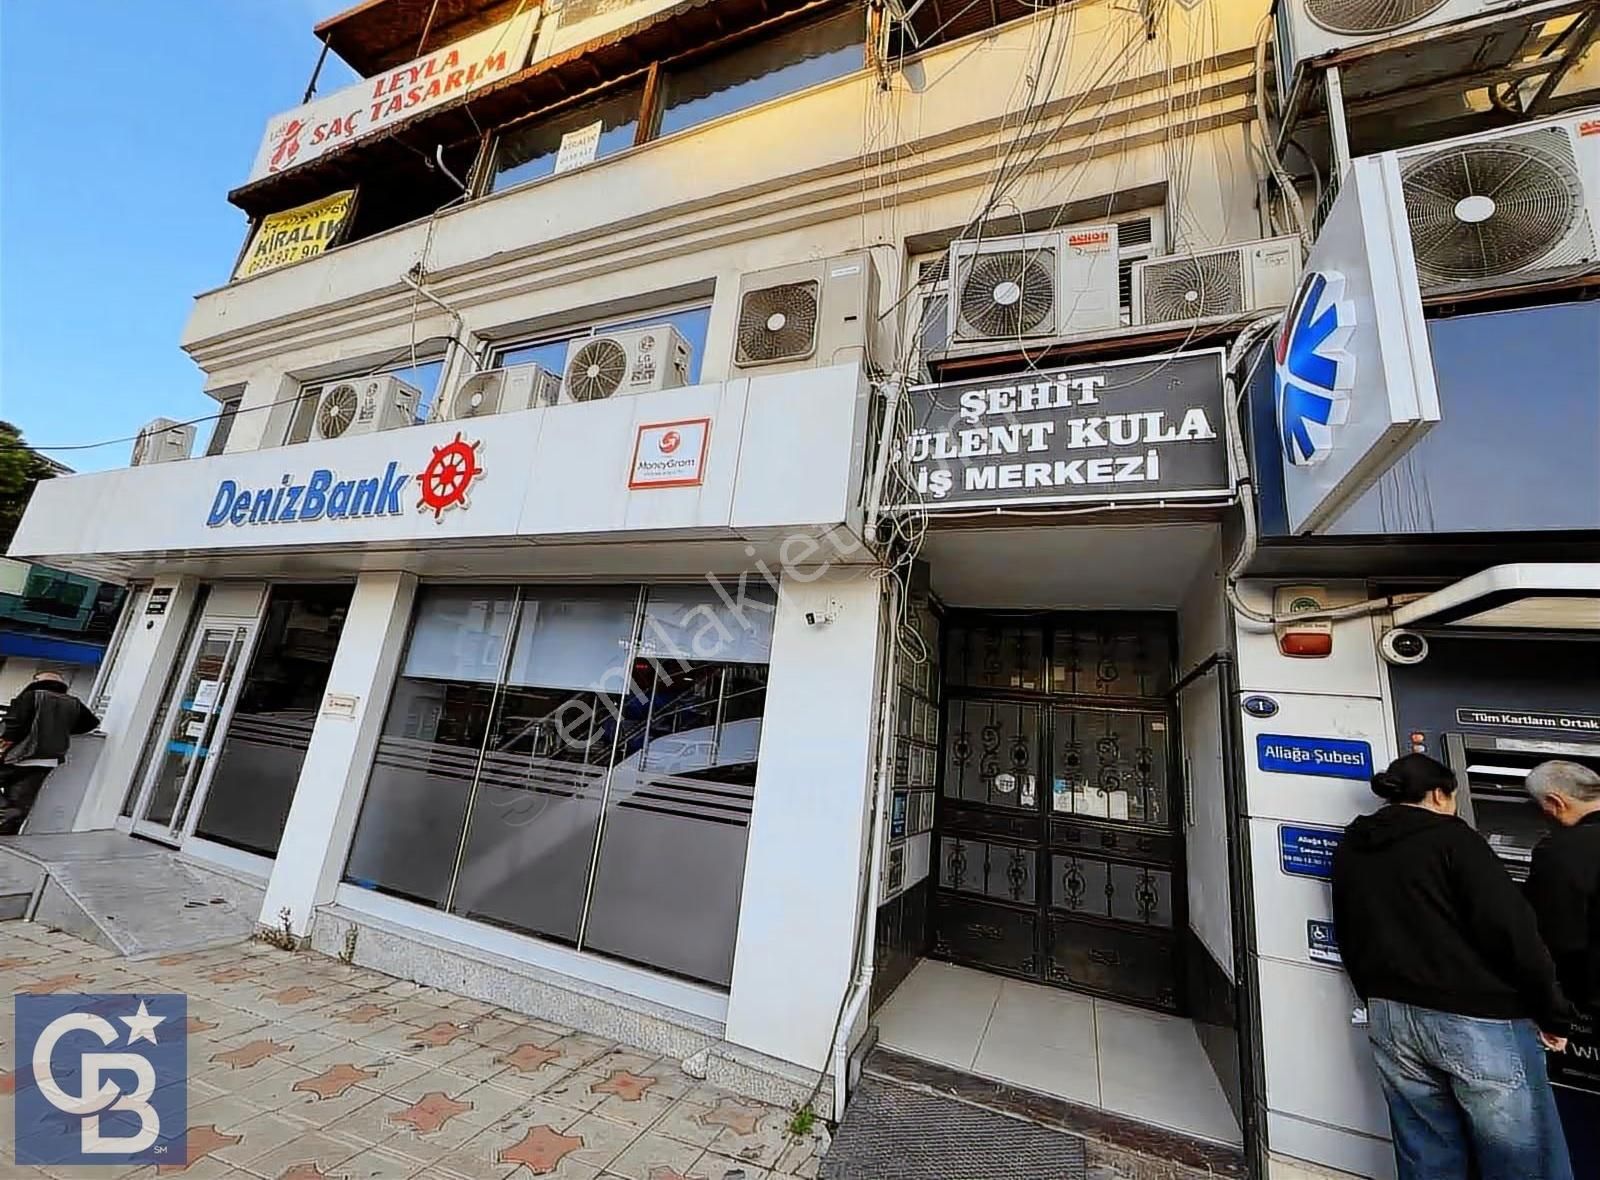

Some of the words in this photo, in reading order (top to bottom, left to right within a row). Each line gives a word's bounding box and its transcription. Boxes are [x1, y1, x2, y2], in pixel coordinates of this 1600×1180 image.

[311, 109, 362, 146] SAÇ
[368, 51, 507, 122] TASARIM
[373, 50, 459, 99] LEYLA
[960, 374, 1106, 424] ŞEHİT
[890, 421, 1054, 462] ÜLENT
[1067, 409, 1217, 450] KULA
[206, 461, 409, 528] DenizBank
[917, 466, 953, 498] İŞ
[965, 450, 1160, 491] MERKEZİ
[1472, 712, 1499, 723] Tüm
[1502, 714, 1556, 727] Kartların
[1560, 718, 1600, 729] Ortak
[1264, 745, 1310, 762] Aliağa
[1313, 749, 1365, 766] Şubesi
